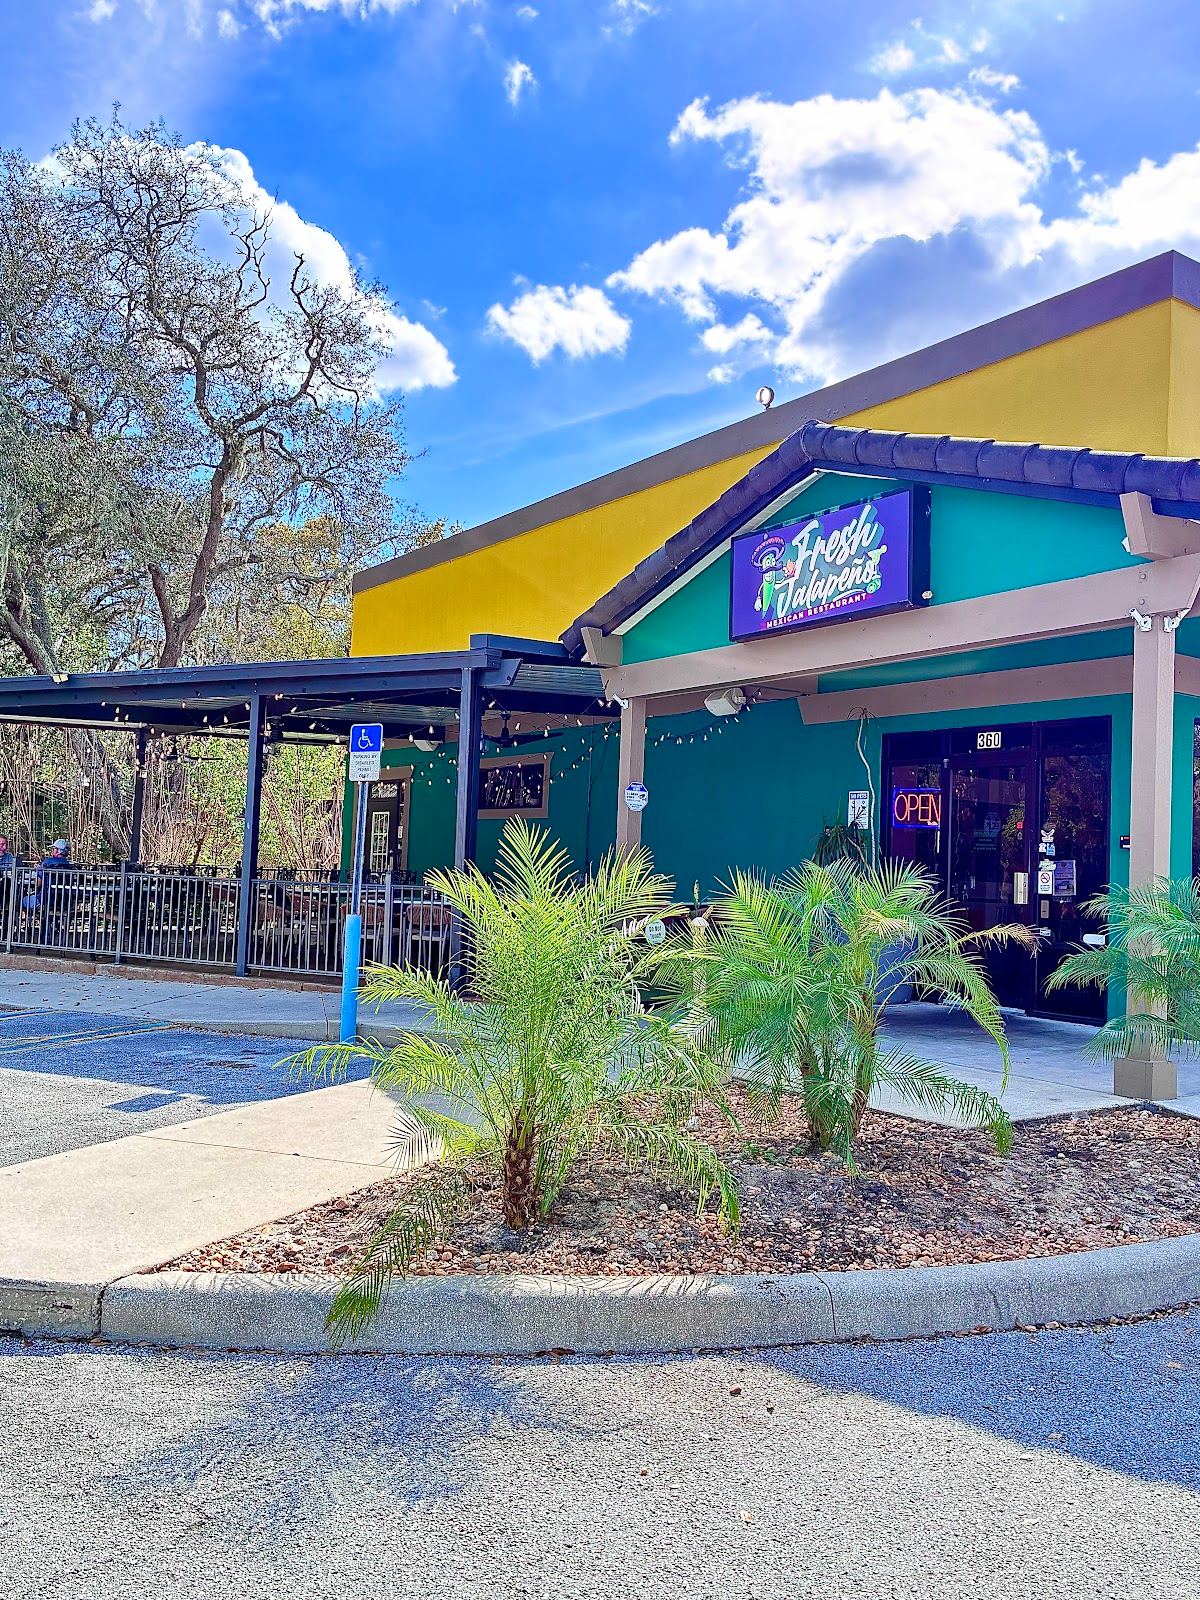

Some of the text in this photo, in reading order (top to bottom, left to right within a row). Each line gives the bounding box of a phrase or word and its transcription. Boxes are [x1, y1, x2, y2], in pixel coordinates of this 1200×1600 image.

[792, 504, 878, 579] Fresh
[774, 557, 875, 618] Jalapeño
[766, 592, 867, 628] MEXICAN RESTAURANT
[979, 733, 999, 747] 360
[895, 794, 941, 821] OPEN
